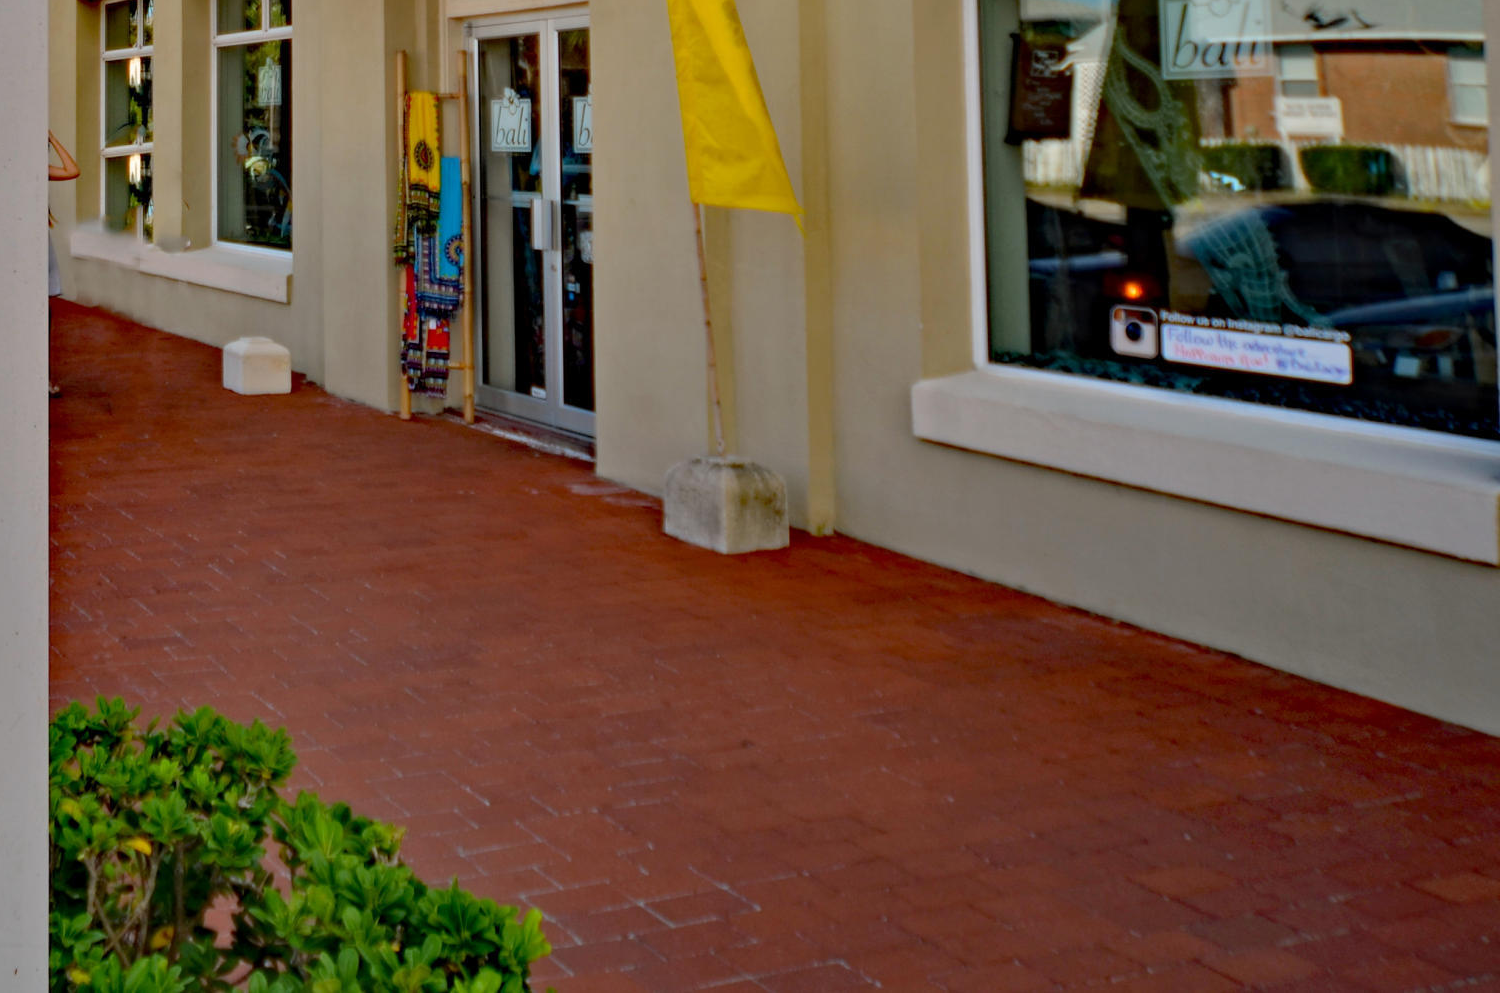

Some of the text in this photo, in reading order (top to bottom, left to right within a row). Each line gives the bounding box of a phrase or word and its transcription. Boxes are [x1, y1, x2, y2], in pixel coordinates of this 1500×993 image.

[1173, 3, 1261, 68] bali
[495, 106, 526, 145] bali
[1161, 310, 1194, 325] Follow
[1197, 317, 1209, 326] us
[1212, 318, 1225, 328] on
